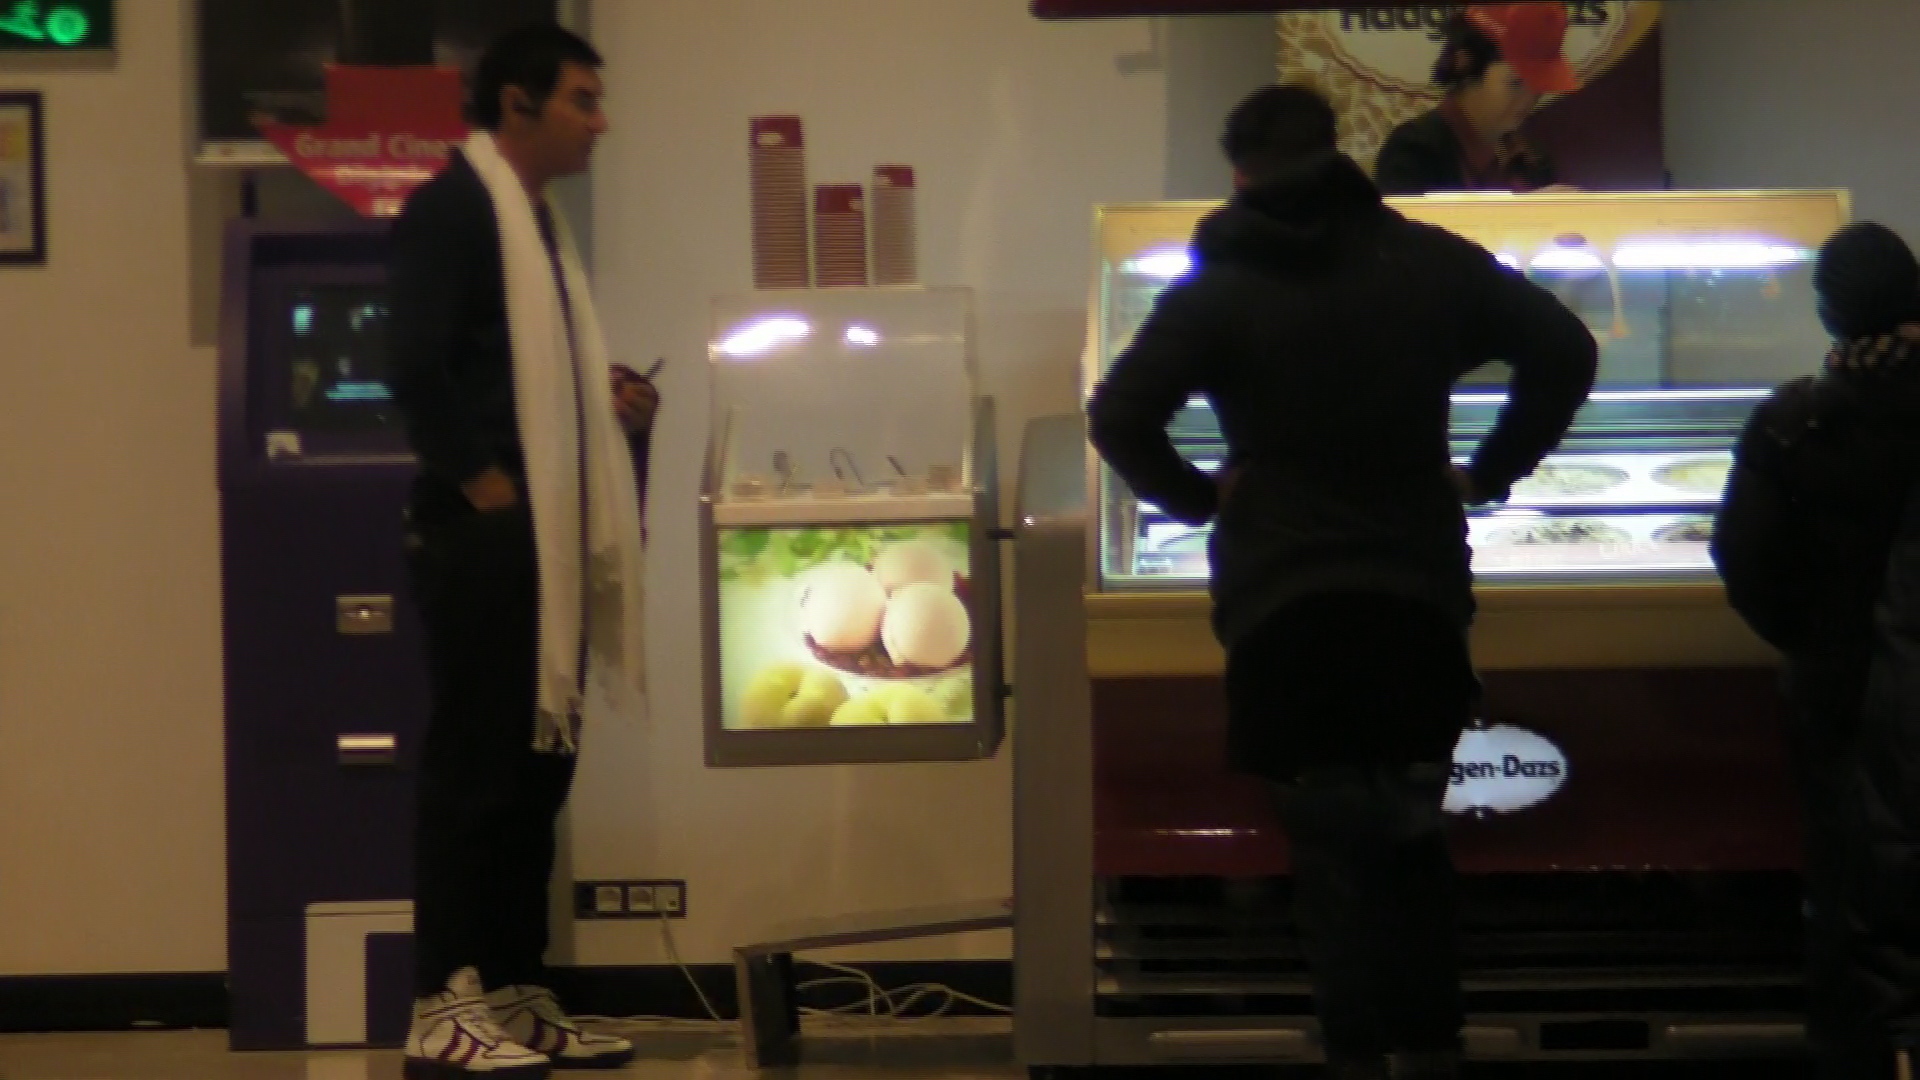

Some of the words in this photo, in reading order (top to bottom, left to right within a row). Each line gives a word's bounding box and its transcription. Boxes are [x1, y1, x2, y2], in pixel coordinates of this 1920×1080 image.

[294, 131, 380, 159] Grand
[387, 133, 448, 160] Cine
[1450, 754, 1561, 786] gen-Dazs
